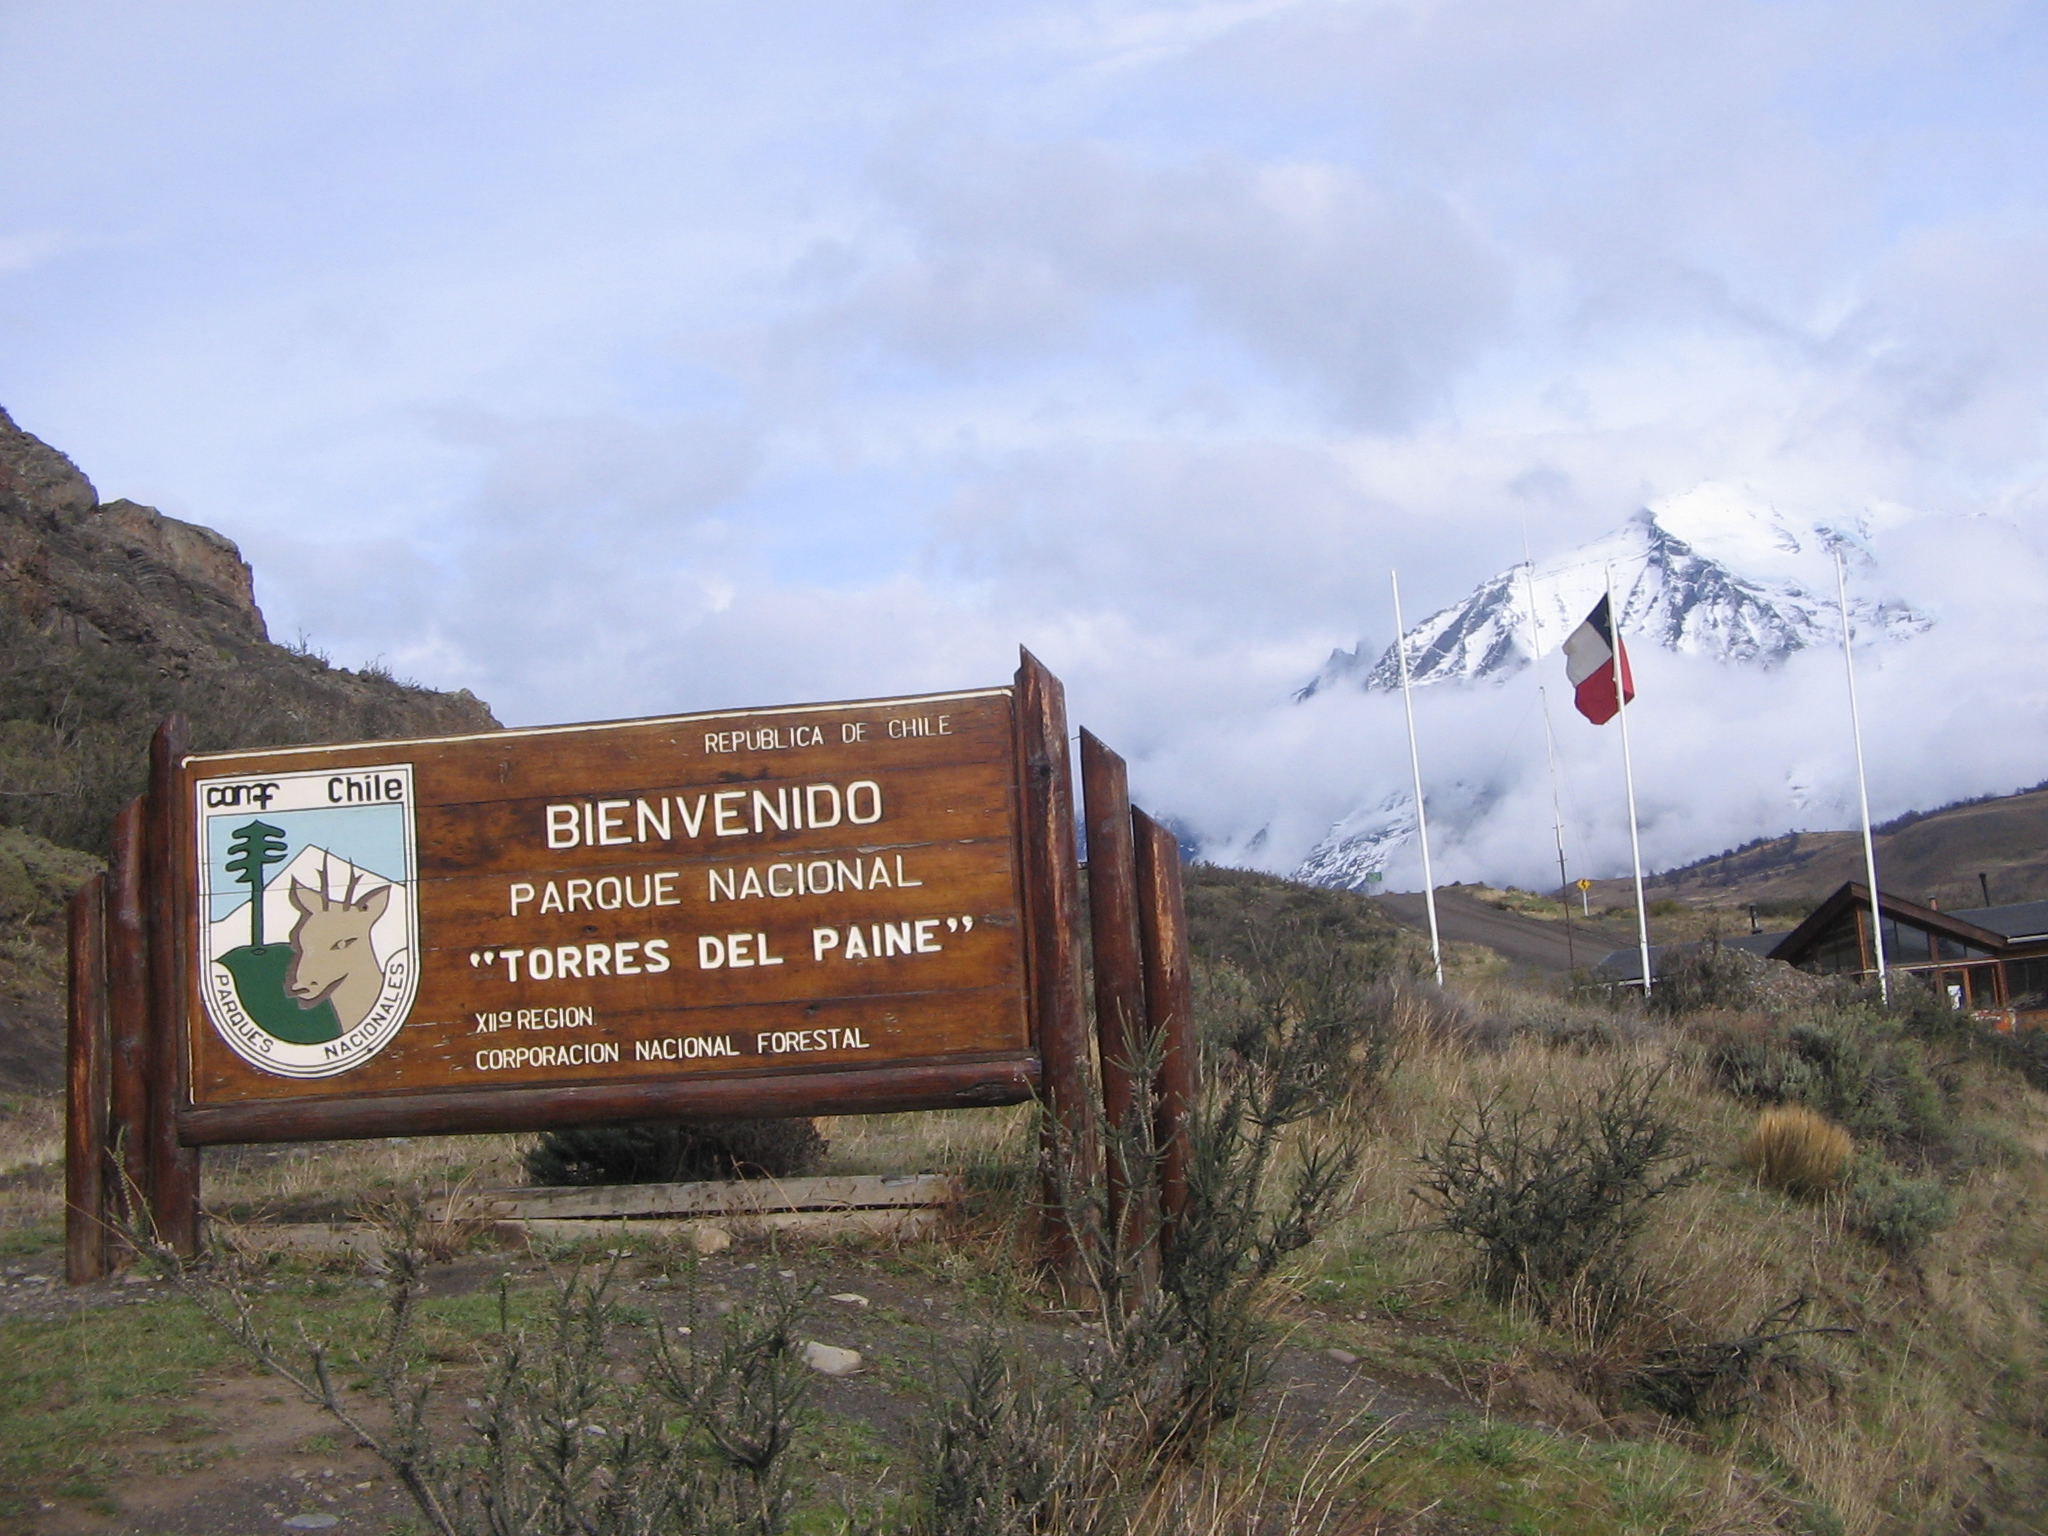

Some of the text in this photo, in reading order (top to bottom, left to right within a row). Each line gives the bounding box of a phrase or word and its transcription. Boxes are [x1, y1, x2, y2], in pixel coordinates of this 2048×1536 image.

[704, 715, 953, 754] REPUBLICA DE CHILE
[327, 774, 404, 803] Chile
[545, 780, 883, 849] BIENVENIDO
[509, 854, 923, 916] PARQUE NACIONAL
[699, 932, 784, 970] DEL
[214, 962, 405, 1060] PARQUES NACIONALES
[517, 1006, 594, 1031] REGION
[475, 1028, 870, 1071] CORPORACION NACIONAL FORESTAL
